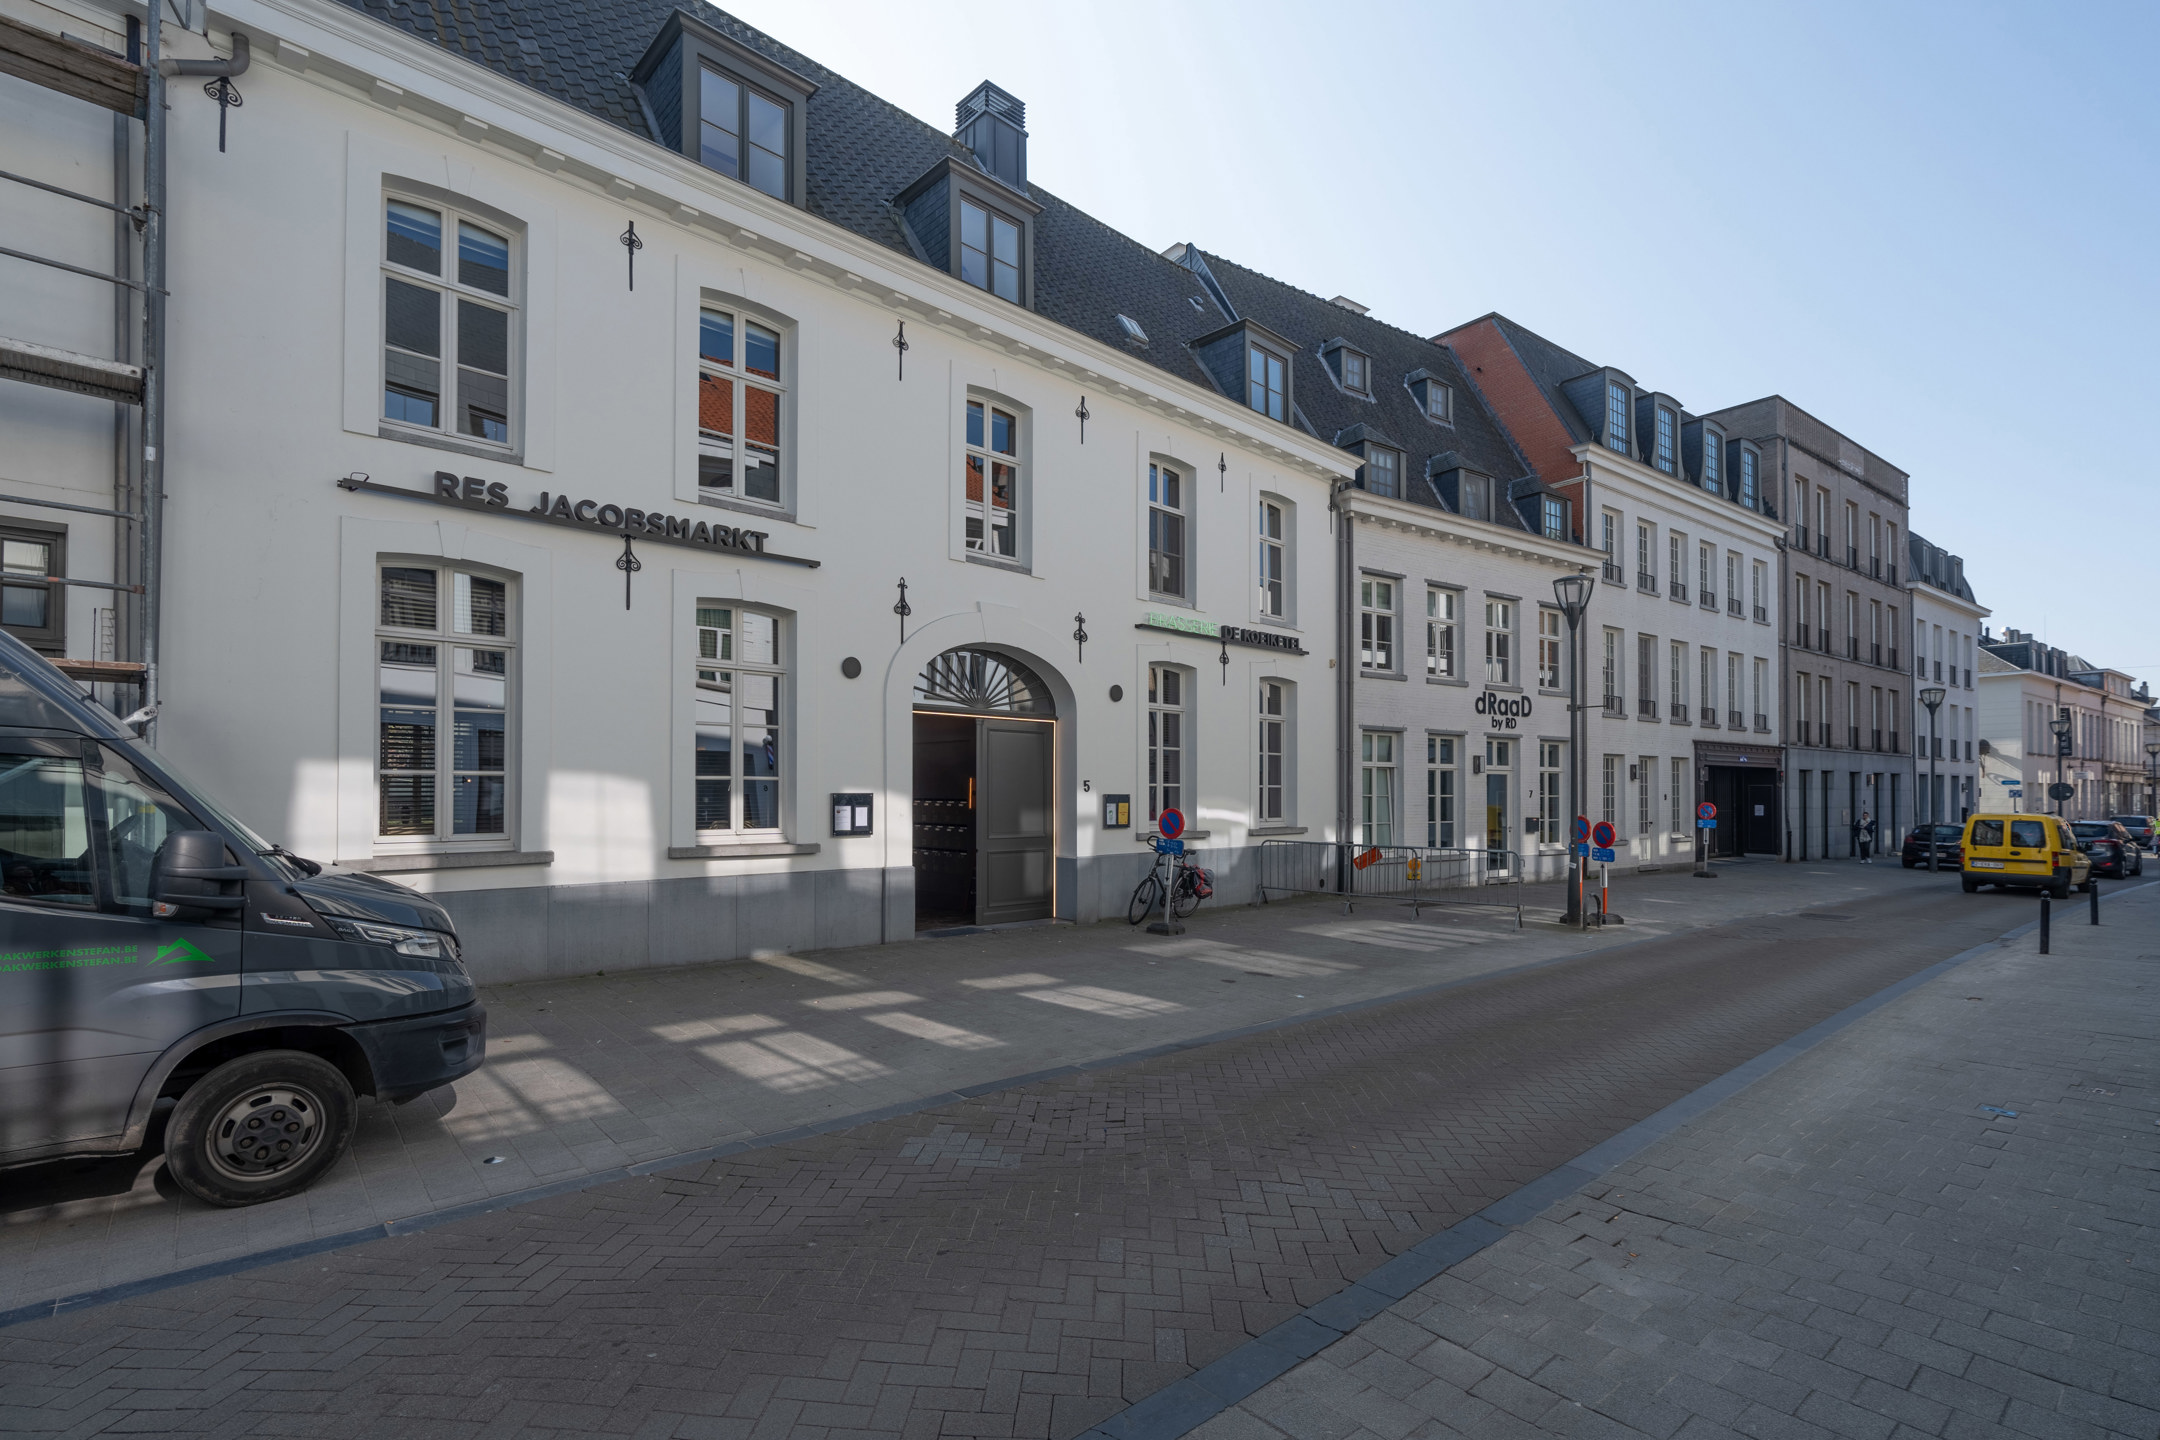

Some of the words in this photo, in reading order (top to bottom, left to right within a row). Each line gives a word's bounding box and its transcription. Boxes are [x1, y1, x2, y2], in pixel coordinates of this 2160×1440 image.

[434, 470, 509, 507] RES
[530, 491, 769, 552] JACOBSMARKT
[1149, 612, 1219, 637] BRASSERIE
[1221, 625, 1240, 641] DE
[1475, 691, 1532, 717] dRaaD
[1491, 716, 1503, 731] by
[1505, 718, 1517, 729] RD
[1083, 780, 1090, 792] 5
[1528, 789, 1534, 799] 7
[0, 945, 138, 962] AKWERKENSTEFAN.BE
[0, 955, 138, 973] AKWERKENSTEFAN.BE
